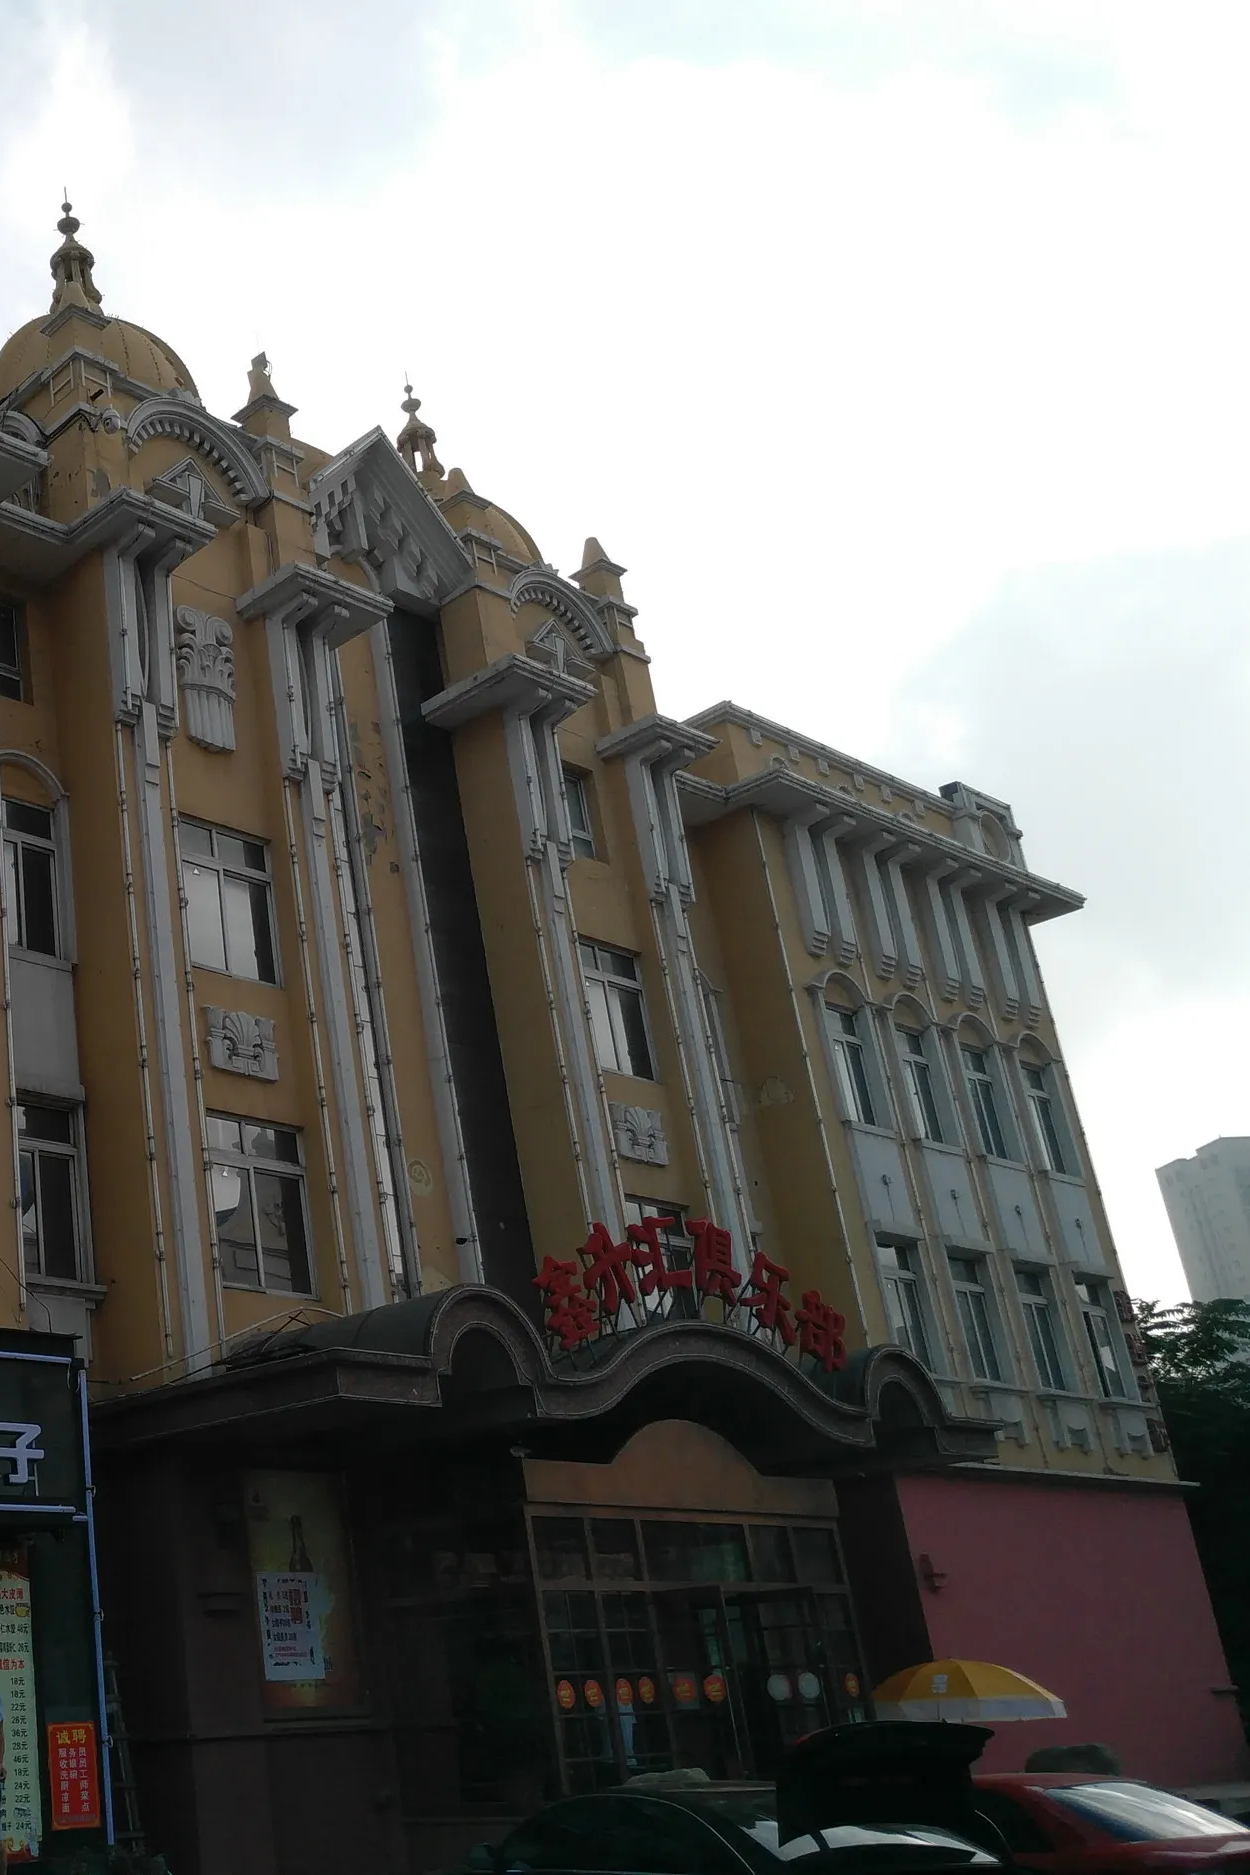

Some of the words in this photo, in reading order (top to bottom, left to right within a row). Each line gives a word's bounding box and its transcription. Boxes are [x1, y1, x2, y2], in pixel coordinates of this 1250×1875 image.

[10, 1677, 26, 1686] 18元
[10, 1690, 26, 1699] 18元
[11, 1702, 27, 1712] 22元
[11, 1715, 27, 1725] 28元
[11, 1728, 28, 1738] 36元
[56, 1729, 87, 1745] 诚聘
[12, 1741, 28, 1751] 28元
[58, 1747, 87, 1758] 服务员
[13, 1754, 29, 1764] 46元
[14, 1767, 30, 1777] 18元
[14, 1781, 31, 1790] 24元
[15, 1794, 31, 1803] 22元
[15, 1821, 32, 1830] 24元
